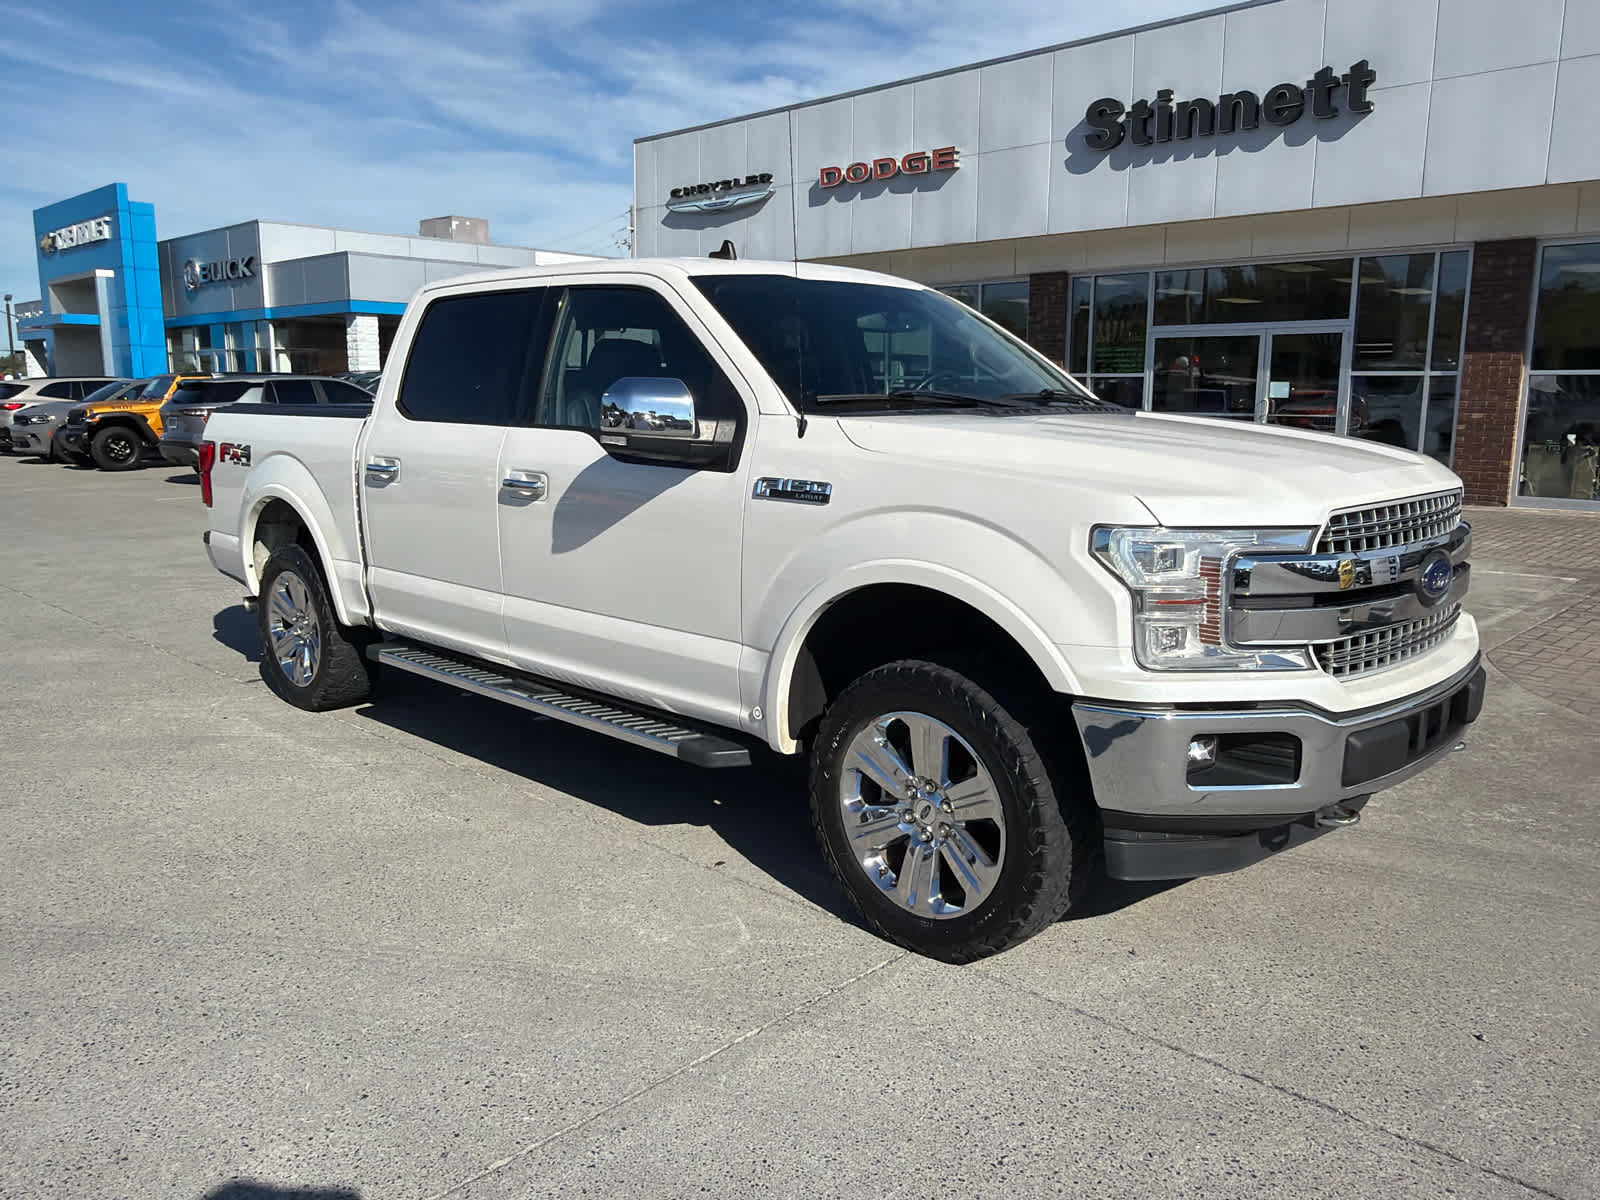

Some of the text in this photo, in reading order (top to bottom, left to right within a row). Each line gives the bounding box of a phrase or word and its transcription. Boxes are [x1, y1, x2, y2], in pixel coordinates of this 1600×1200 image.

[1085, 59, 1376, 150] Stinnett
[819, 146, 960, 187] DODGE
[670, 173, 773, 198] CHRYSLER
[199, 257, 254, 283] BUICK
[220, 442, 251, 463] FX4
